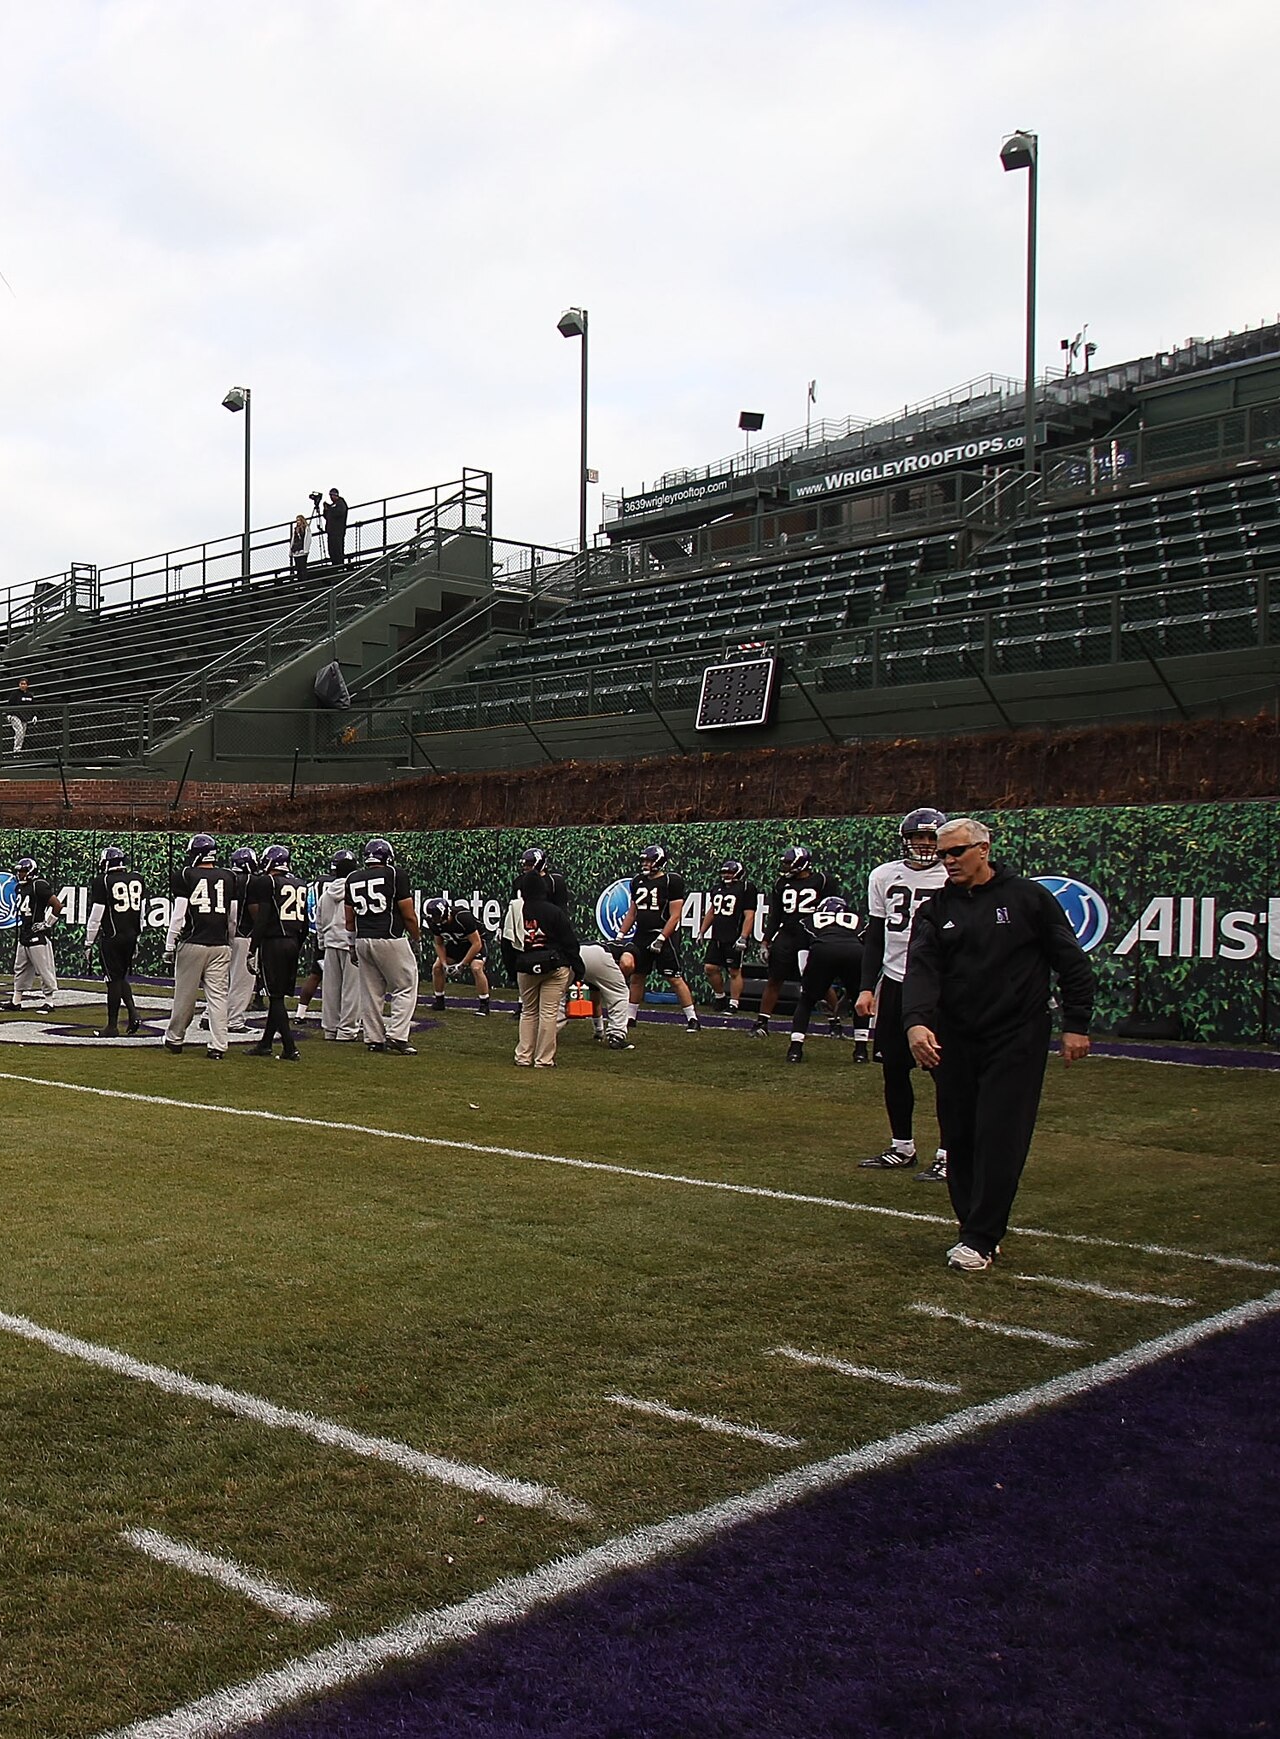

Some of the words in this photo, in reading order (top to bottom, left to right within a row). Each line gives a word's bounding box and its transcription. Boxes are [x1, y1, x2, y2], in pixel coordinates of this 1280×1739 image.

[624, 480, 728, 513] 3639wrigleyrooftop.com
[112, 880, 142, 912] 98
[190, 878, 226, 914] 41
[350, 878, 387, 916] 55
[636, 888, 660, 911] 21
[714, 894, 736, 916] 93
[782, 888, 817, 914] 92
[812, 912, 860, 930] 60
[532, 964, 542, 974] G
[570, 990, 578, 998] G
